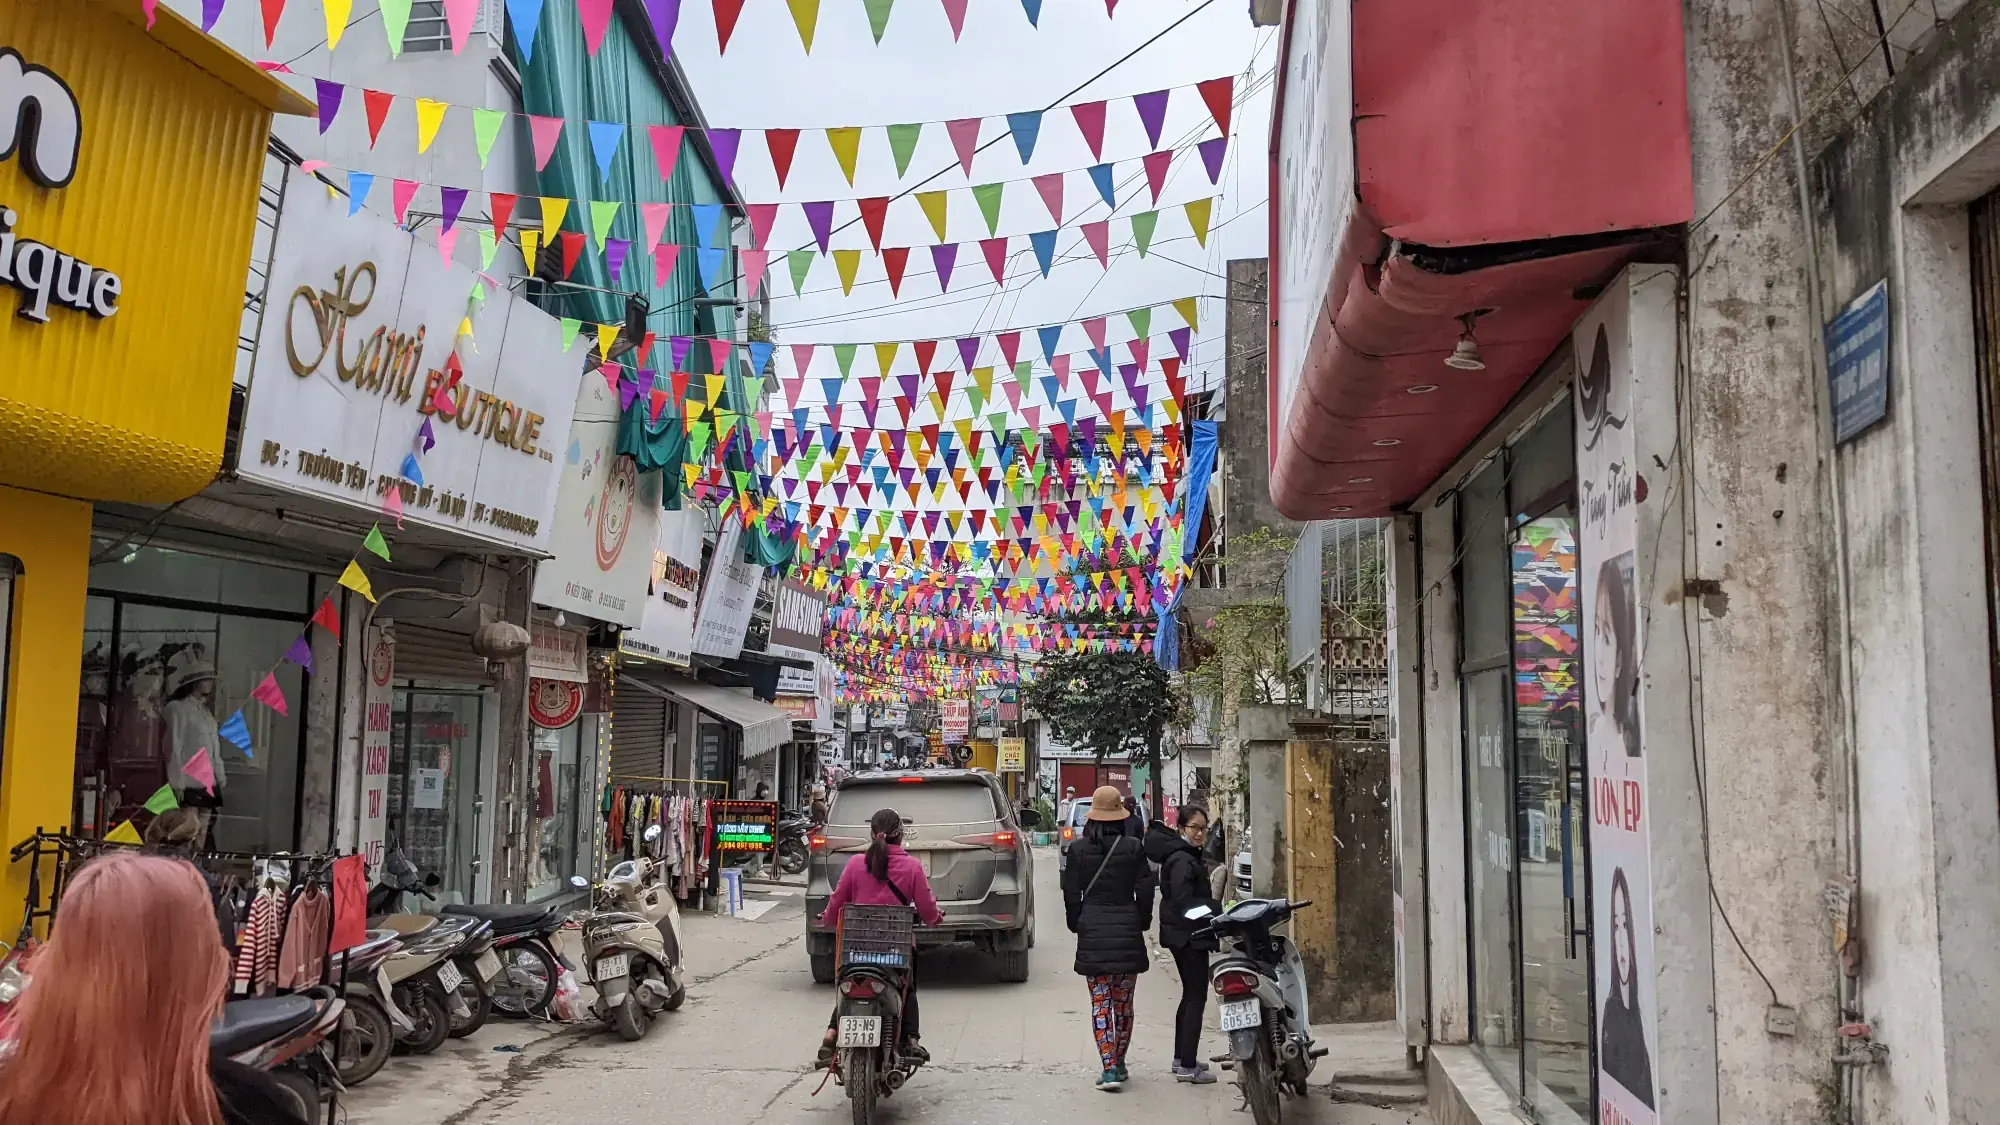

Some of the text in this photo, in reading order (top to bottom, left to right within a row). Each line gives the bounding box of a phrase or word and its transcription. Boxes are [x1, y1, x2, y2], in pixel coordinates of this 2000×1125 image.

[286, 260, 425, 407] Hami
[777, 585, 823, 637] SAMSUNG
[368, 696, 390, 732] HÀNG
[366, 740, 388, 775] XÁCH
[368, 788, 382, 819] TAY
[1593, 749, 1620, 829] UỐN
[1622, 762, 1641, 833] ÉP
[1223, 1012, 1258, 1030] 805.53
[1225, 1001, 1253, 1016] 29-X1
[844, 1032, 874, 1045] 5718
